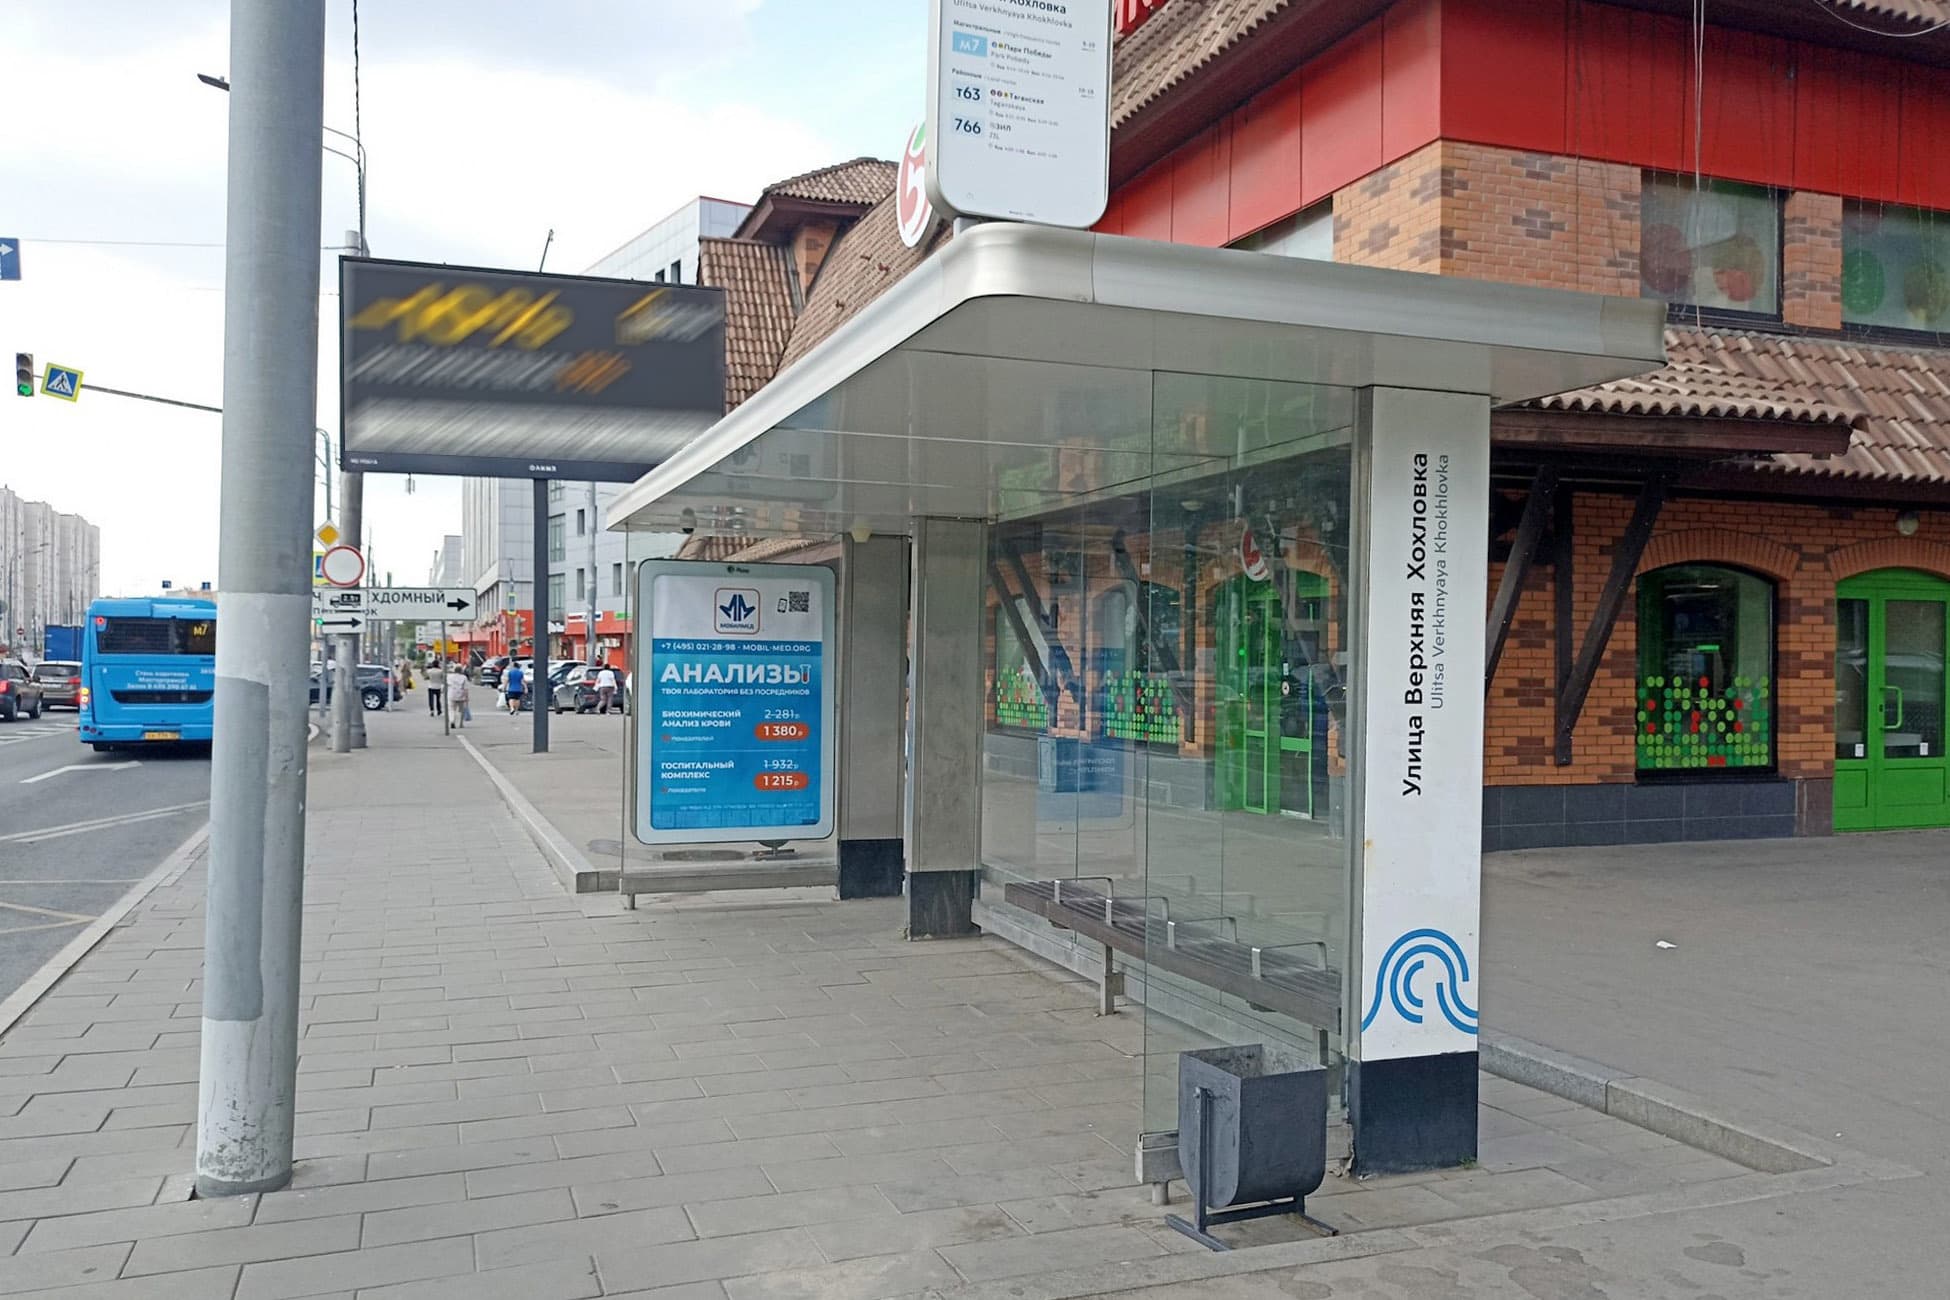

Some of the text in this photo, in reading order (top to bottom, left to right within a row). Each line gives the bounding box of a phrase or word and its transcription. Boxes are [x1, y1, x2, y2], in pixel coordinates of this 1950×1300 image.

[980, 4, 1025, 19] Verkhnyaya
[1026, 13, 1073, 28] Khokhlovka
[956, 86, 981, 101] т63
[954, 118, 982, 134] 766
[1430, 454, 1449, 709] Ulitsa Verkhnyaya Khokhlovka
[313, 589, 446, 604] ЧХДОМНЫЙ
[1402, 453, 1428, 796] Улица Верхняя Хохловка
[661, 642, 671, 650] +7
[673, 642, 695, 651] (495)
[683, 688, 738, 696] ЛАБОРАТОРИЯ
[740, 688, 754, 696] БЕЗ
[755, 688, 810, 697] ПОСРЕДНИКОВ
[661, 709, 741, 718] БИОХИМИЧЕСКИЙ
[661, 720, 731, 728] АНАЛИЗ КРОВИ
[661, 760, 735, 769] ГОСПИТАЛЬНЫЙ
[661, 771, 711, 779] КОМПЛЕКС
